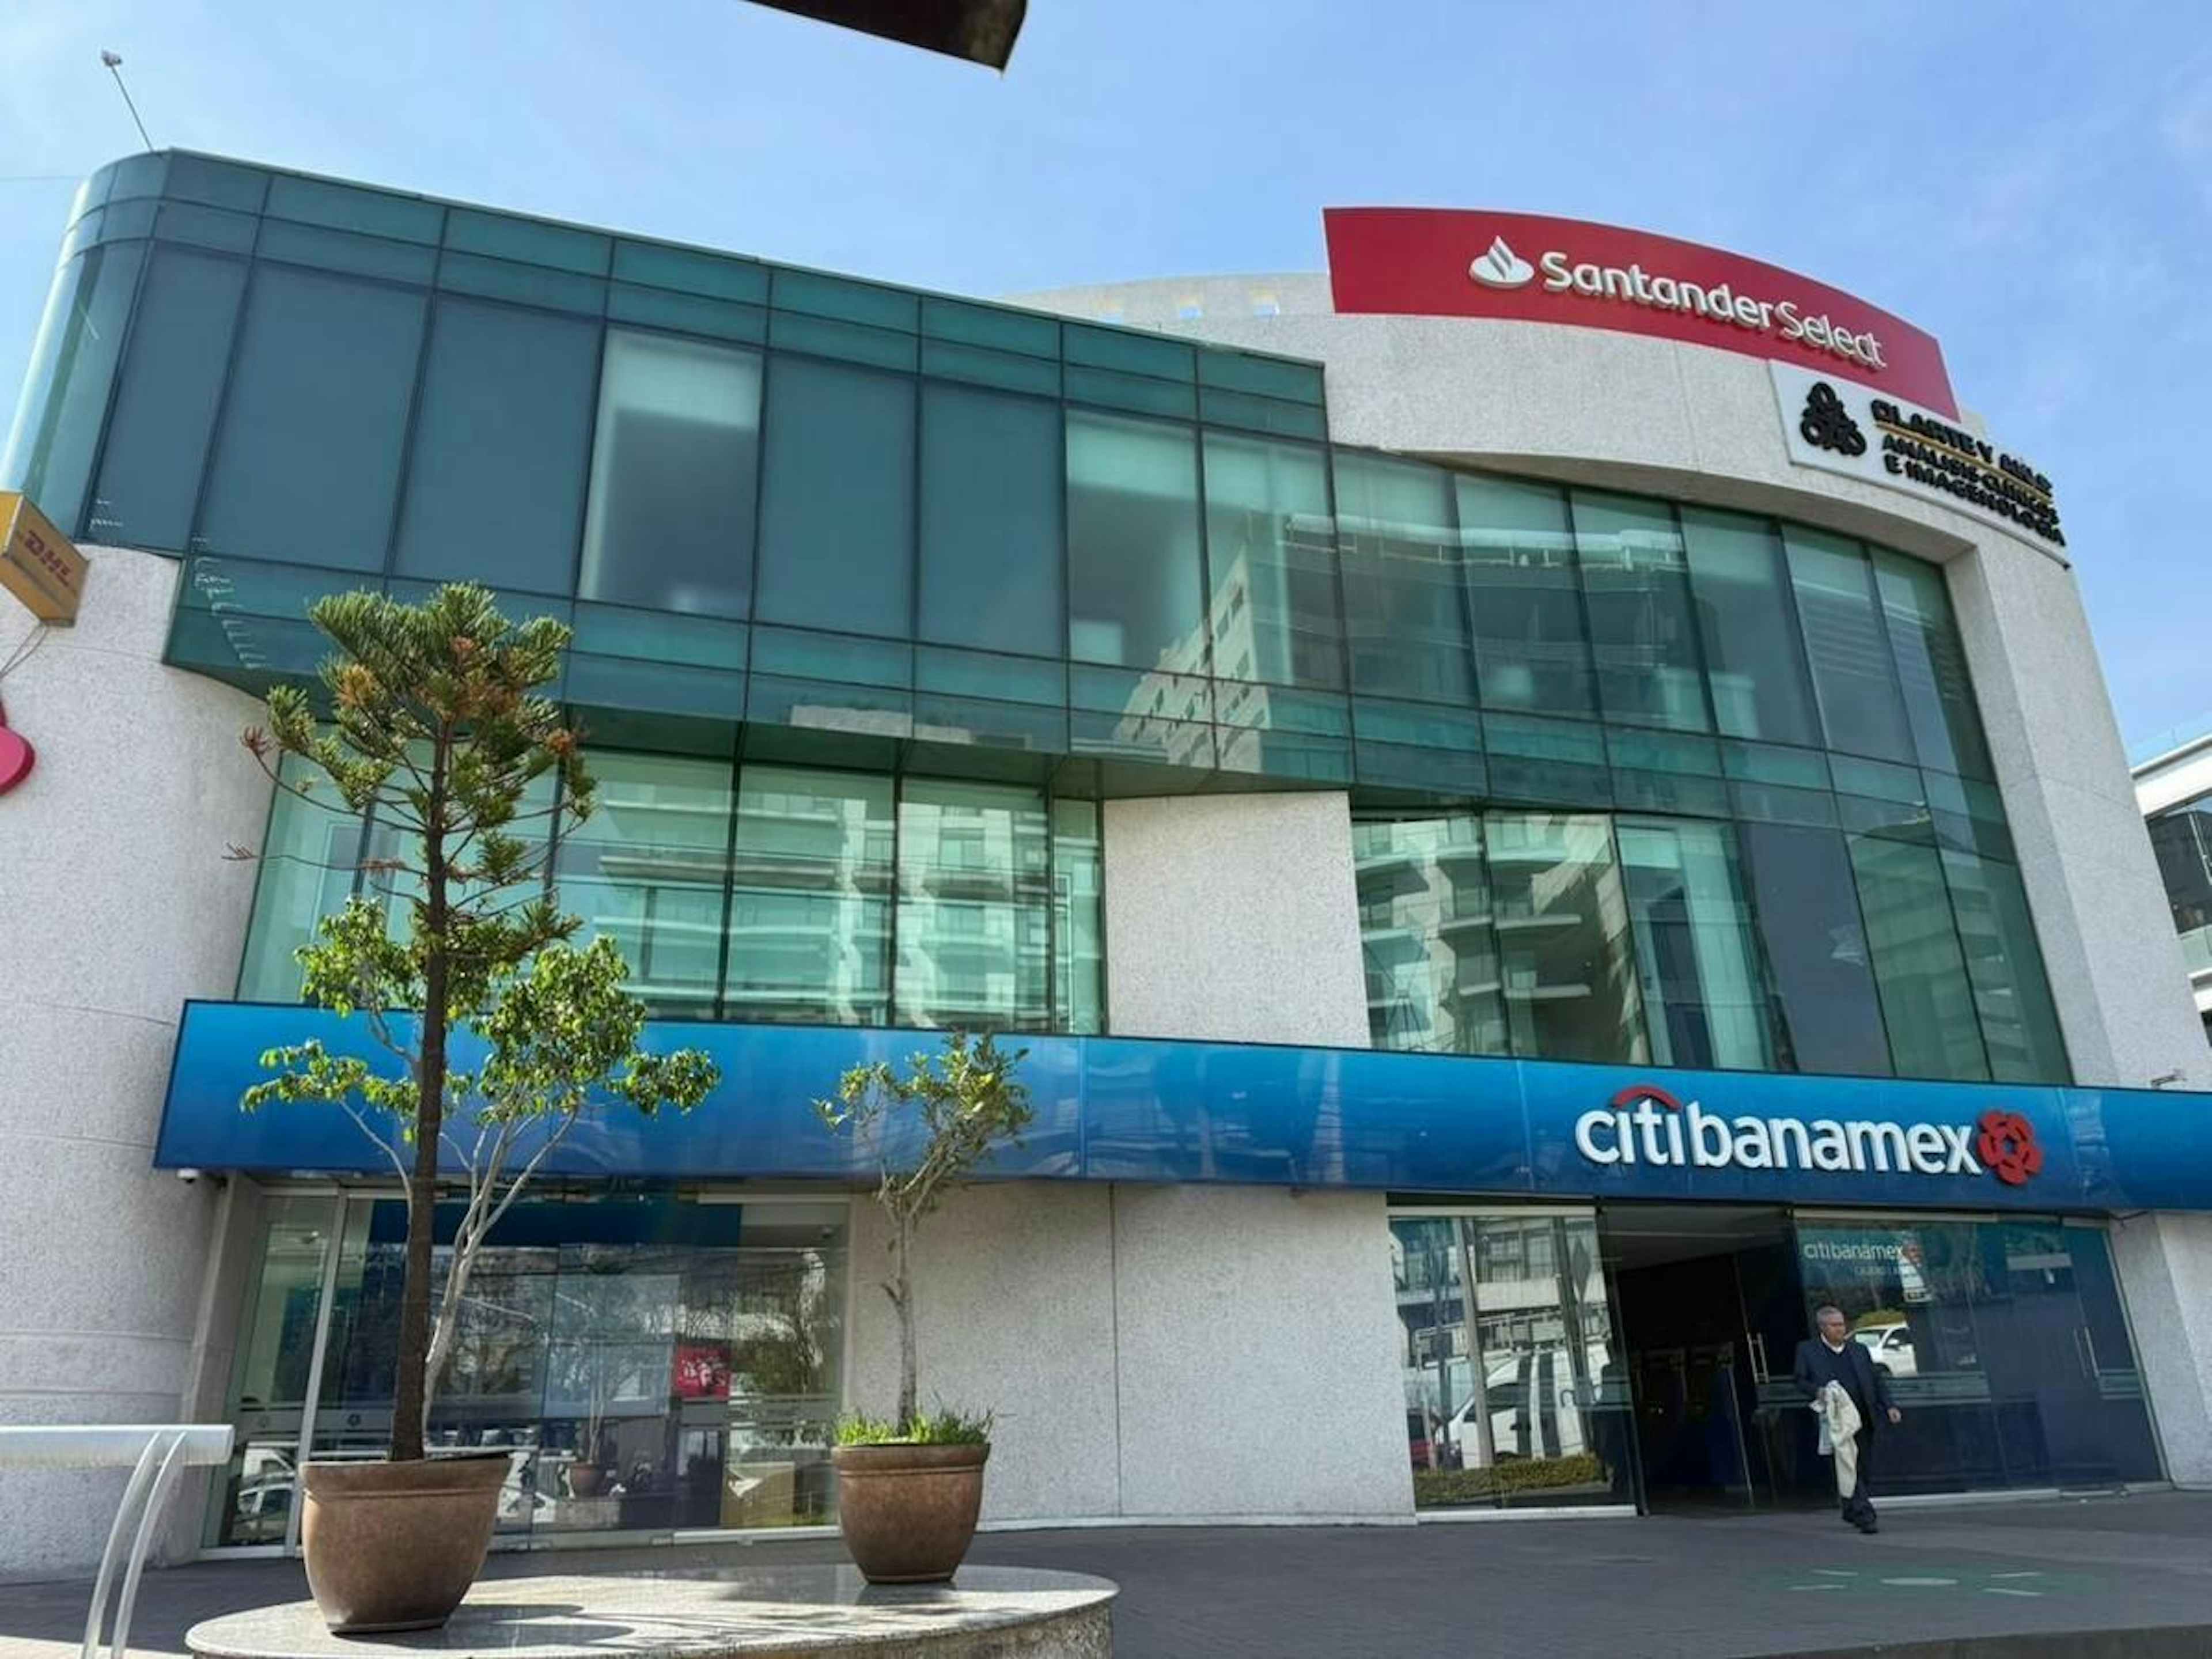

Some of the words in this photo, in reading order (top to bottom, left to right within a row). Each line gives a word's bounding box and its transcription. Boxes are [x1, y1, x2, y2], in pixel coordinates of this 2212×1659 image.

[1976, 441, 1993, 463] Y
[1884, 454, 1903, 474] E
[24, 529, 71, 588] DHL
[1575, 1098, 1983, 1175] citibanamex
[1803, 1240, 1904, 1261] citibanamex
